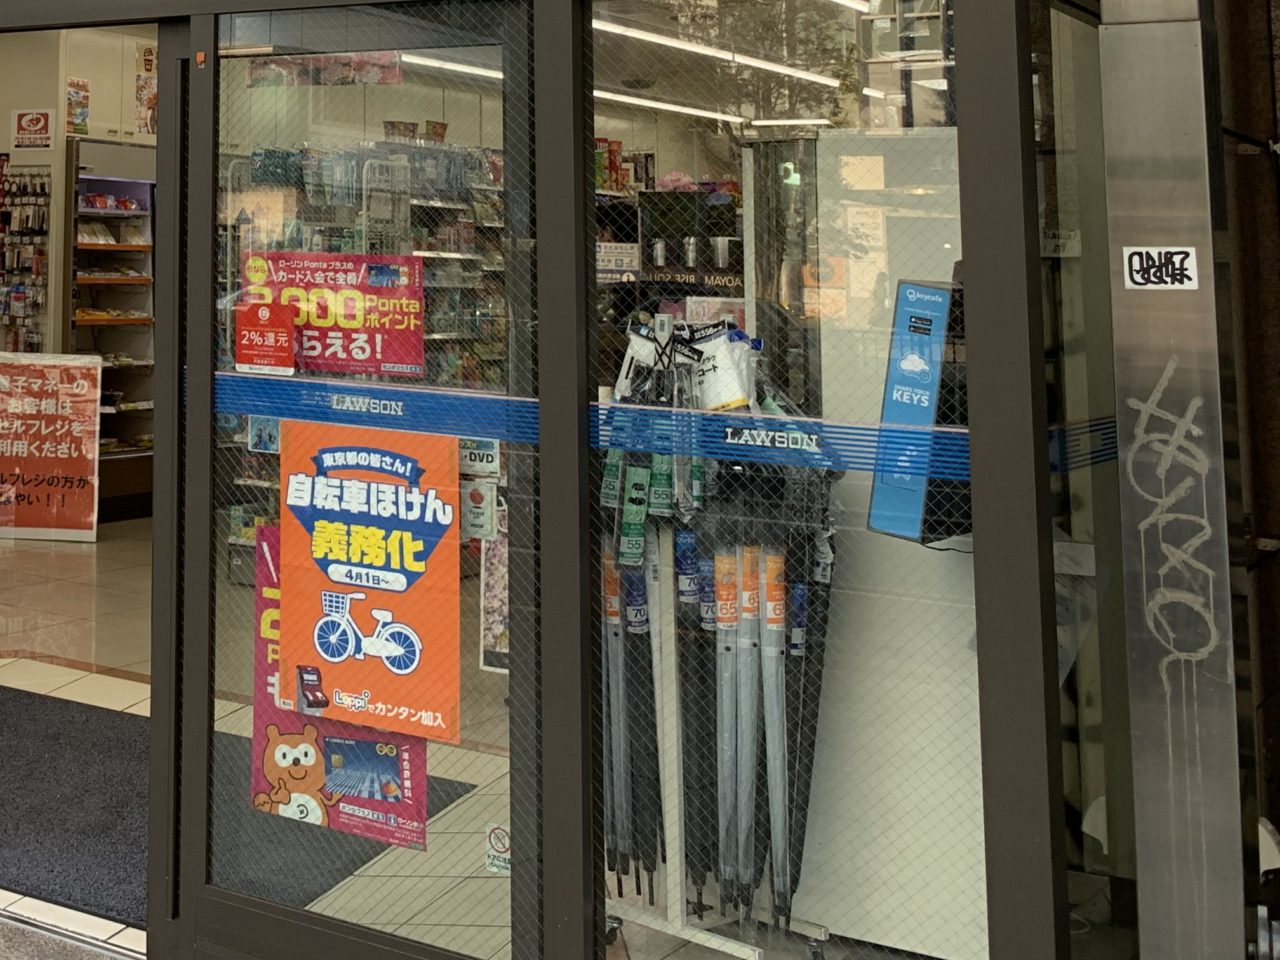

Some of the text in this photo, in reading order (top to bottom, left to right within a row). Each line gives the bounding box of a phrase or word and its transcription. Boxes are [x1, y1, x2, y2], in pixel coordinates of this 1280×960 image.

[365, 295, 420, 312] Ponta
[365, 313, 422, 331] ポイント
[298, 330, 382, 360] らえる!
[331, 394, 403, 416] LAWSON
[892, 390, 929, 407] KEYS
[725, 428, 820, 452] LAWSON
[285, 472, 454, 526] 自転車ほけん
[653, 489, 668, 500] 55
[311, 519, 427, 573] 義務化
[627, 539, 641, 549] 55
[632, 607, 645, 618] 70
[720, 602, 737, 616] 65
